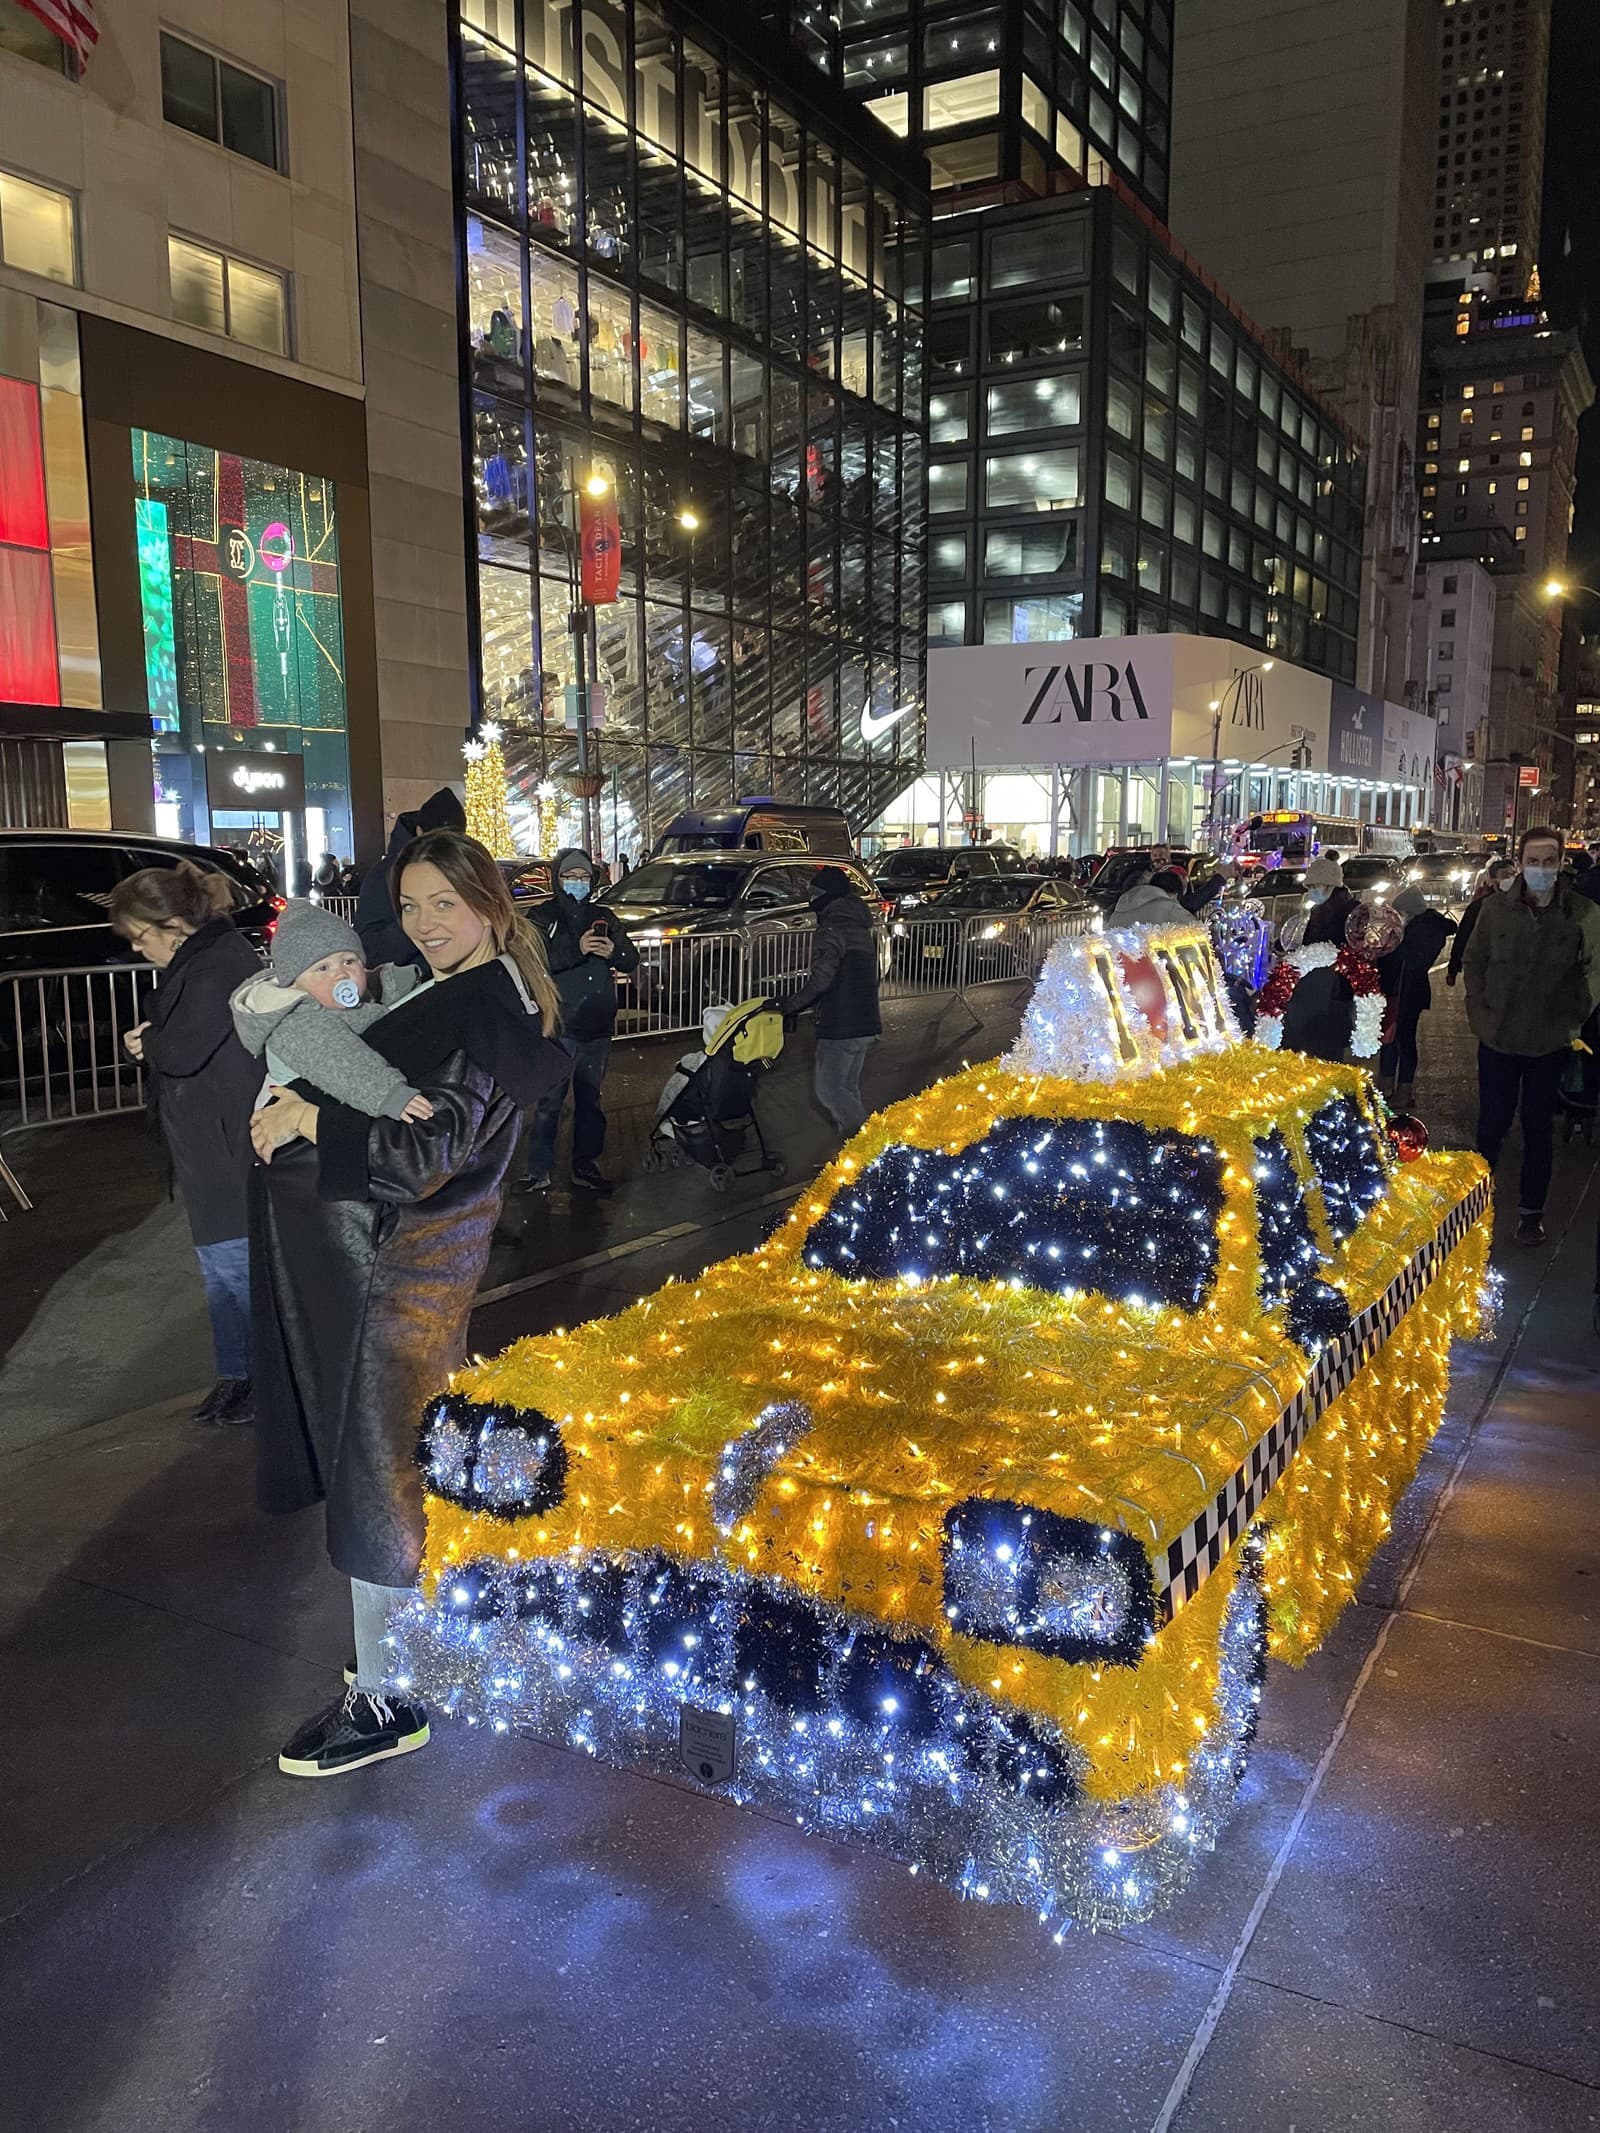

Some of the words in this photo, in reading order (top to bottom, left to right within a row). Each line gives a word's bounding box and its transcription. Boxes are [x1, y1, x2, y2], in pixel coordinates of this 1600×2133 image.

[460, 0, 678, 150] UST
[593, 510, 602, 540] DEAN
[594, 544, 603, 583] TACITA
[1021, 659, 1155, 724] ZARA
[233, 766, 285, 793] dyson
